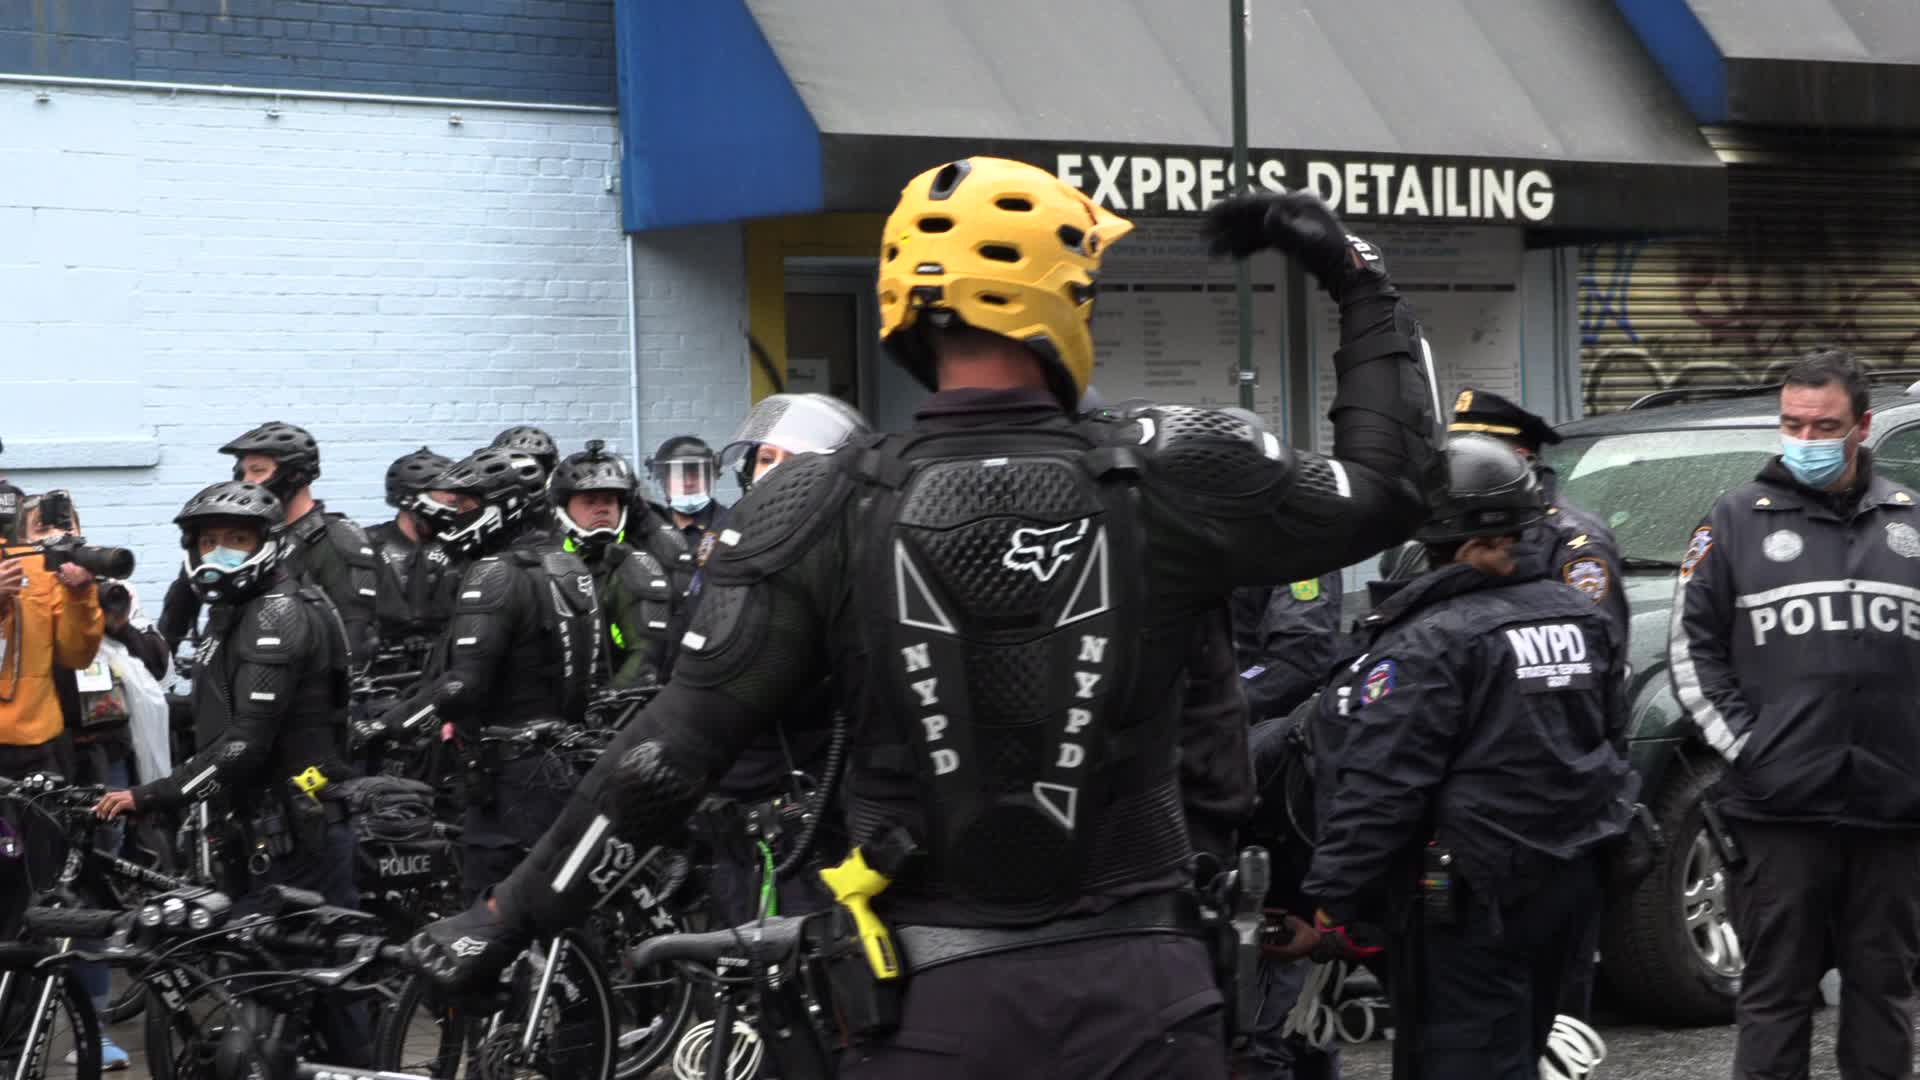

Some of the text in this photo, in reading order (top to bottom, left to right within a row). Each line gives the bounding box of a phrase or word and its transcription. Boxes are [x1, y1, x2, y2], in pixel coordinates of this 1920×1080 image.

[1307, 161, 1554, 221] DETAILING
[1505, 624, 1586, 666] NYPD
[1750, 594, 1920, 646] POLICE
[901, 642, 960, 776] NYPD
[1055, 635, 1109, 768] NYPD
[379, 854, 432, 878] POLICE
